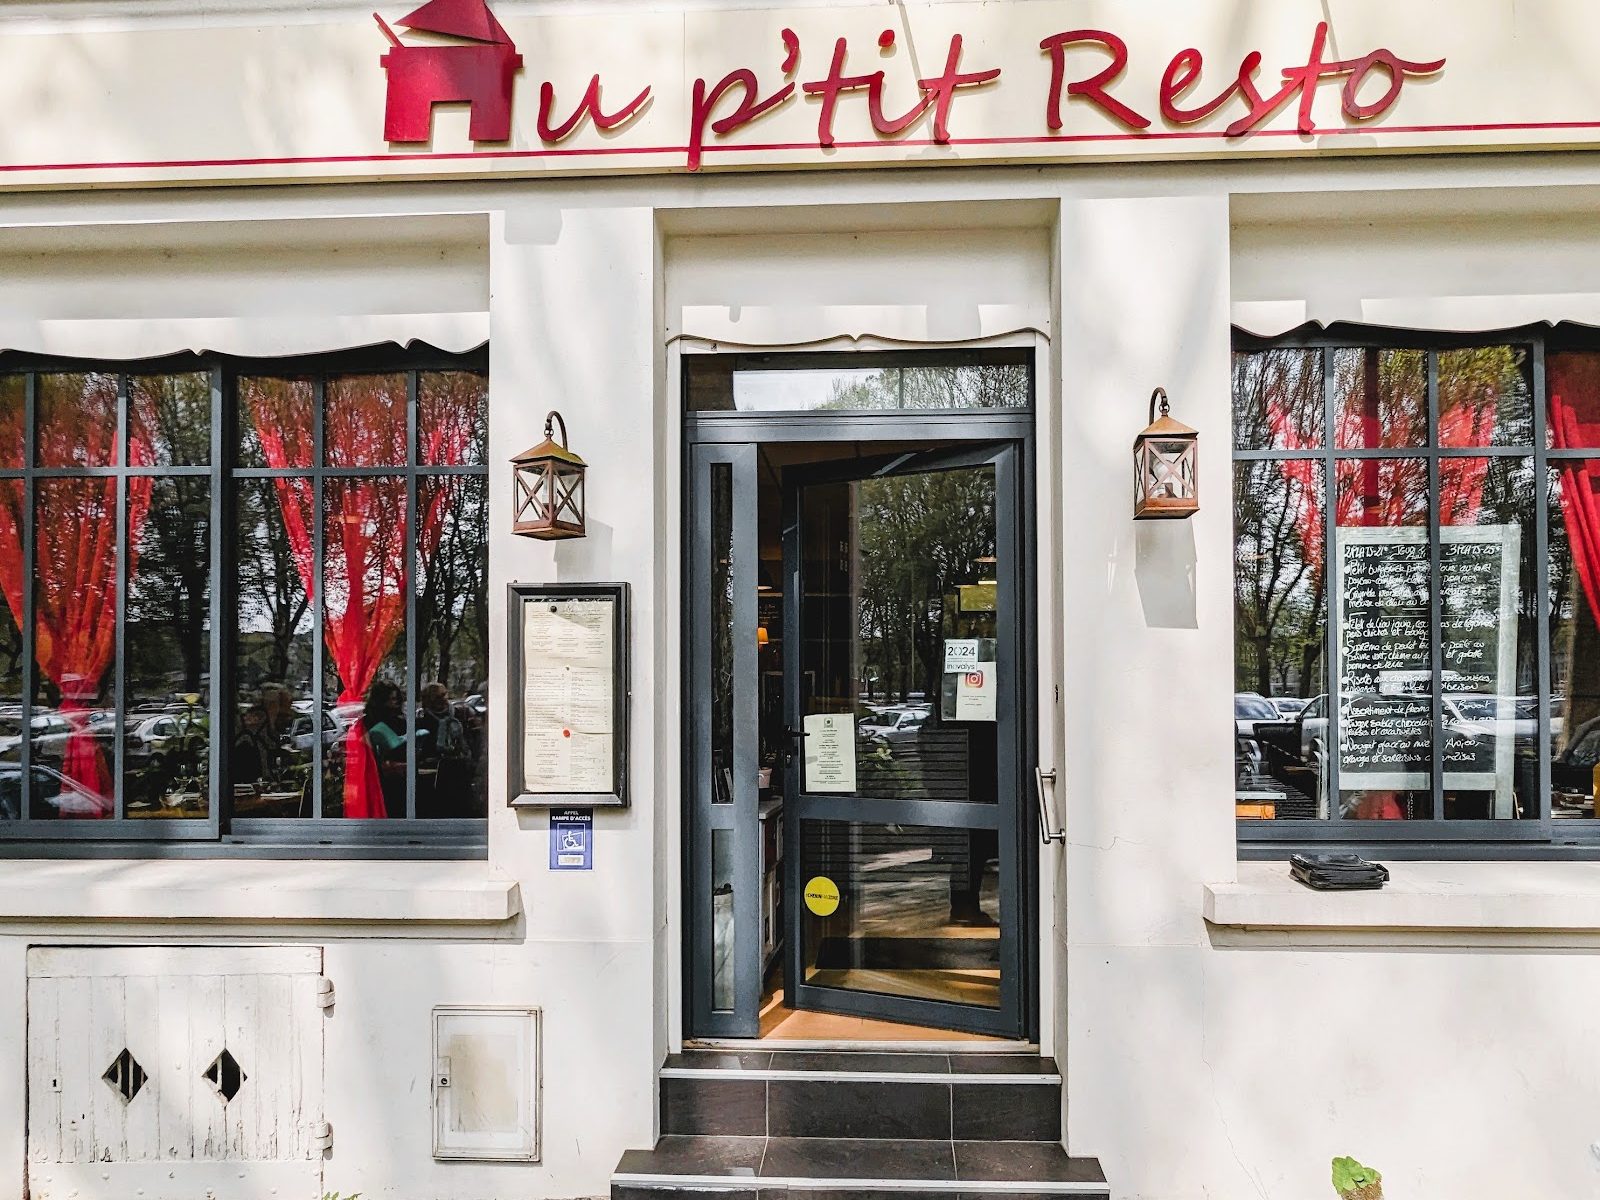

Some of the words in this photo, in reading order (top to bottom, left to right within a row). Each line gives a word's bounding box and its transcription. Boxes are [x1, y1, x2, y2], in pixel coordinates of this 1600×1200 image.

[687, 28, 1001, 171] p'tit
[1040, 21, 1447, 138] Resto
[948, 646, 976, 656] 2024
